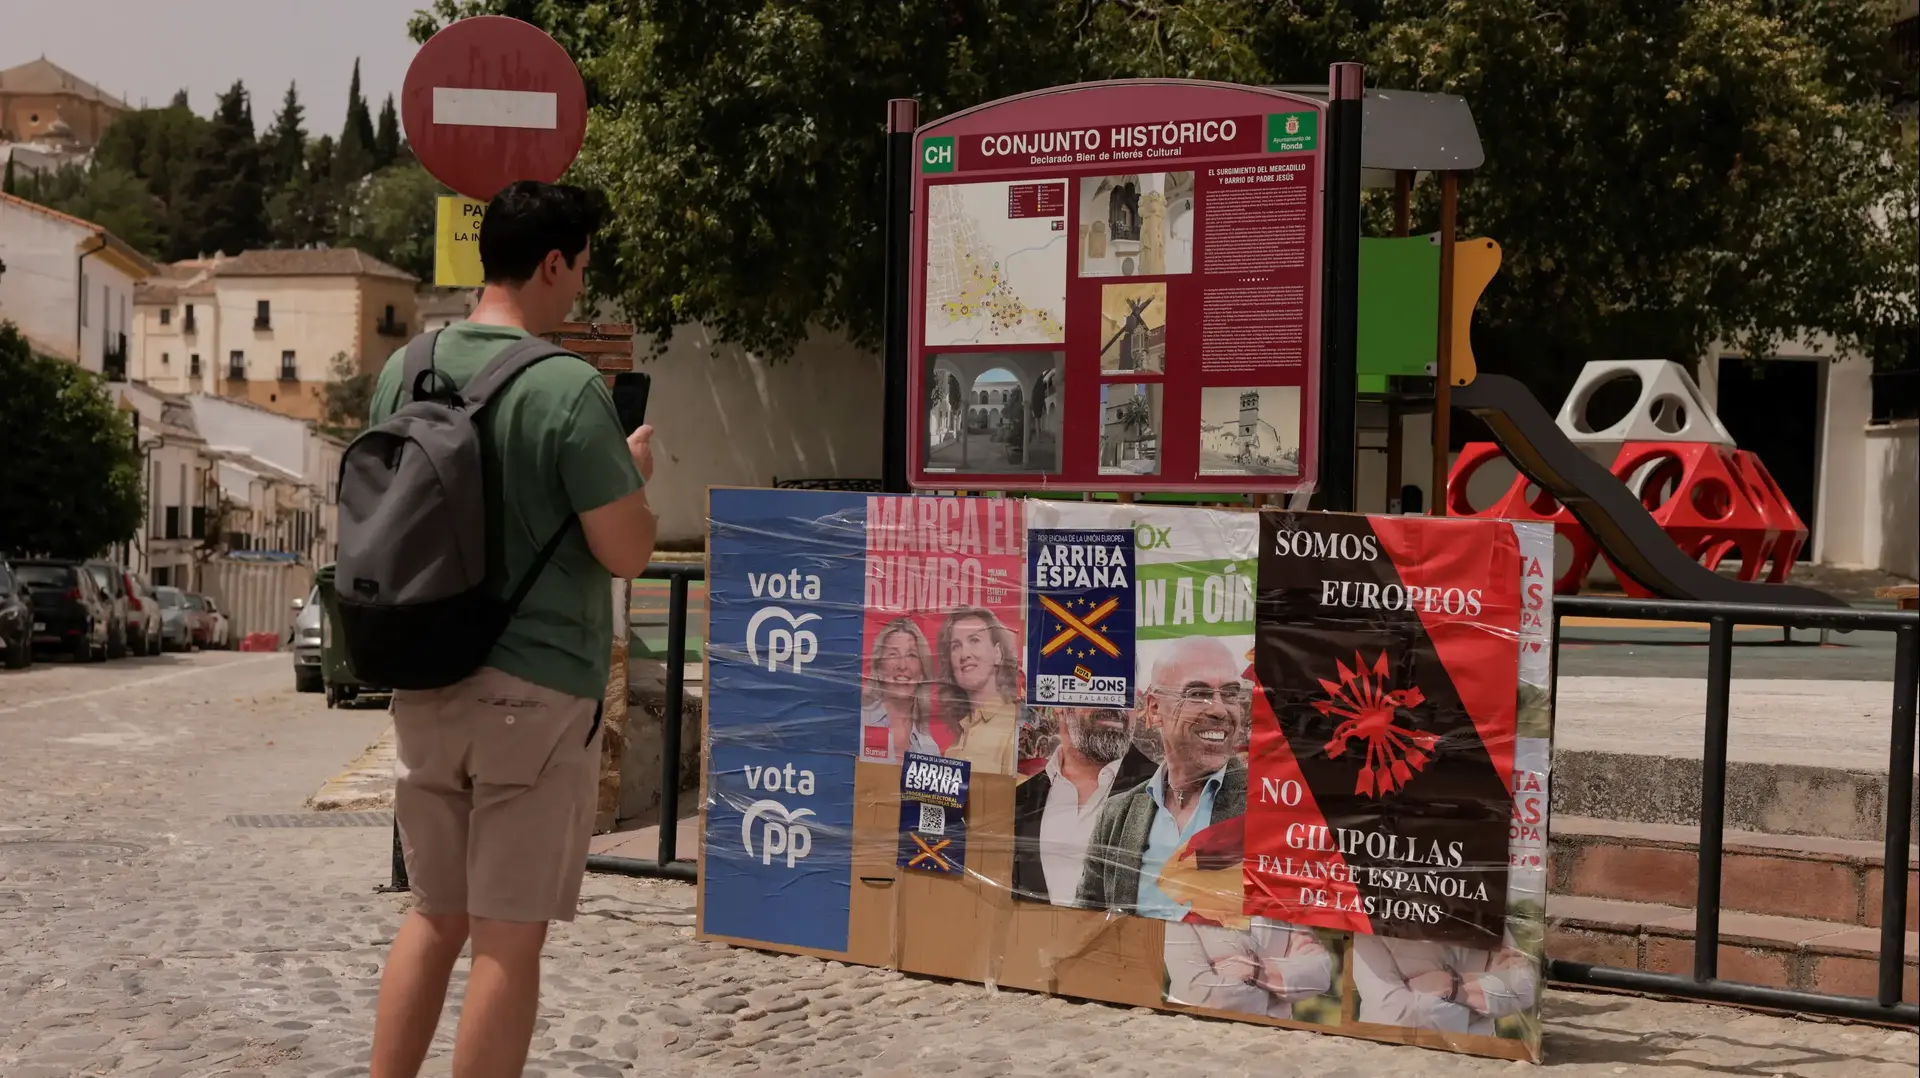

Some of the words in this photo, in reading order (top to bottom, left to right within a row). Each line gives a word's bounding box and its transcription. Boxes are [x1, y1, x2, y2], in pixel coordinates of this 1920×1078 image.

[981, 129, 1100, 156] CONJUNTO
[1111, 120, 1236, 148] HISTÓRICO
[925, 146, 951, 164] CH
[1031, 154, 1073, 165] Declarado
[1076, 152, 1095, 162] Bien
[1099, 151, 1110, 160] de
[1113, 149, 1143, 160] Interés
[1146, 147, 1182, 157] Cultural
[1208, 168, 1215, 176] EL
[1216, 167, 1256, 175] SURGIMIENTO
[1257, 165, 1268, 173] DEL
[1269, 163, 1306, 172] MERCADILLO
[1224, 176, 1245, 184] BARRIO
[1256, 174, 1275, 182] PADRE
[1276, 172, 1295, 181] JESÚS
[454, 232, 468, 241] LA
[866, 496, 981, 555] MARCA
[987, 498, 1019, 556] EL
[1037, 534, 1048, 542] POR
[1048, 534, 1068, 543] ENCIMA
[1084, 533, 1100, 543] UNIÓN
[1101, 534, 1125, 543] EUROPEA
[1037, 544, 1127, 567] ARRIBA
[1275, 530, 1378, 561] SOMOS
[748, 568, 821, 600] vota
[865, 554, 982, 613] RUMBO
[1320, 580, 1482, 616] EUROPEOS
[1172, 577, 1195, 625] A
[1062, 679, 1076, 690] FE
[1089, 680, 1125, 692] JONS
[744, 762, 815, 795] vota
[906, 761, 963, 783] ARRIBA
[1260, 777, 1302, 806] NO
[1286, 822, 1464, 868] GILIPOLLAS
[1257, 854, 1361, 885] FALANGE
[1368, 866, 1489, 902] ESPAÑOLA
[1299, 888, 1328, 908] DE
[1335, 892, 1376, 915] LAS
[1381, 900, 1441, 924] JONS
